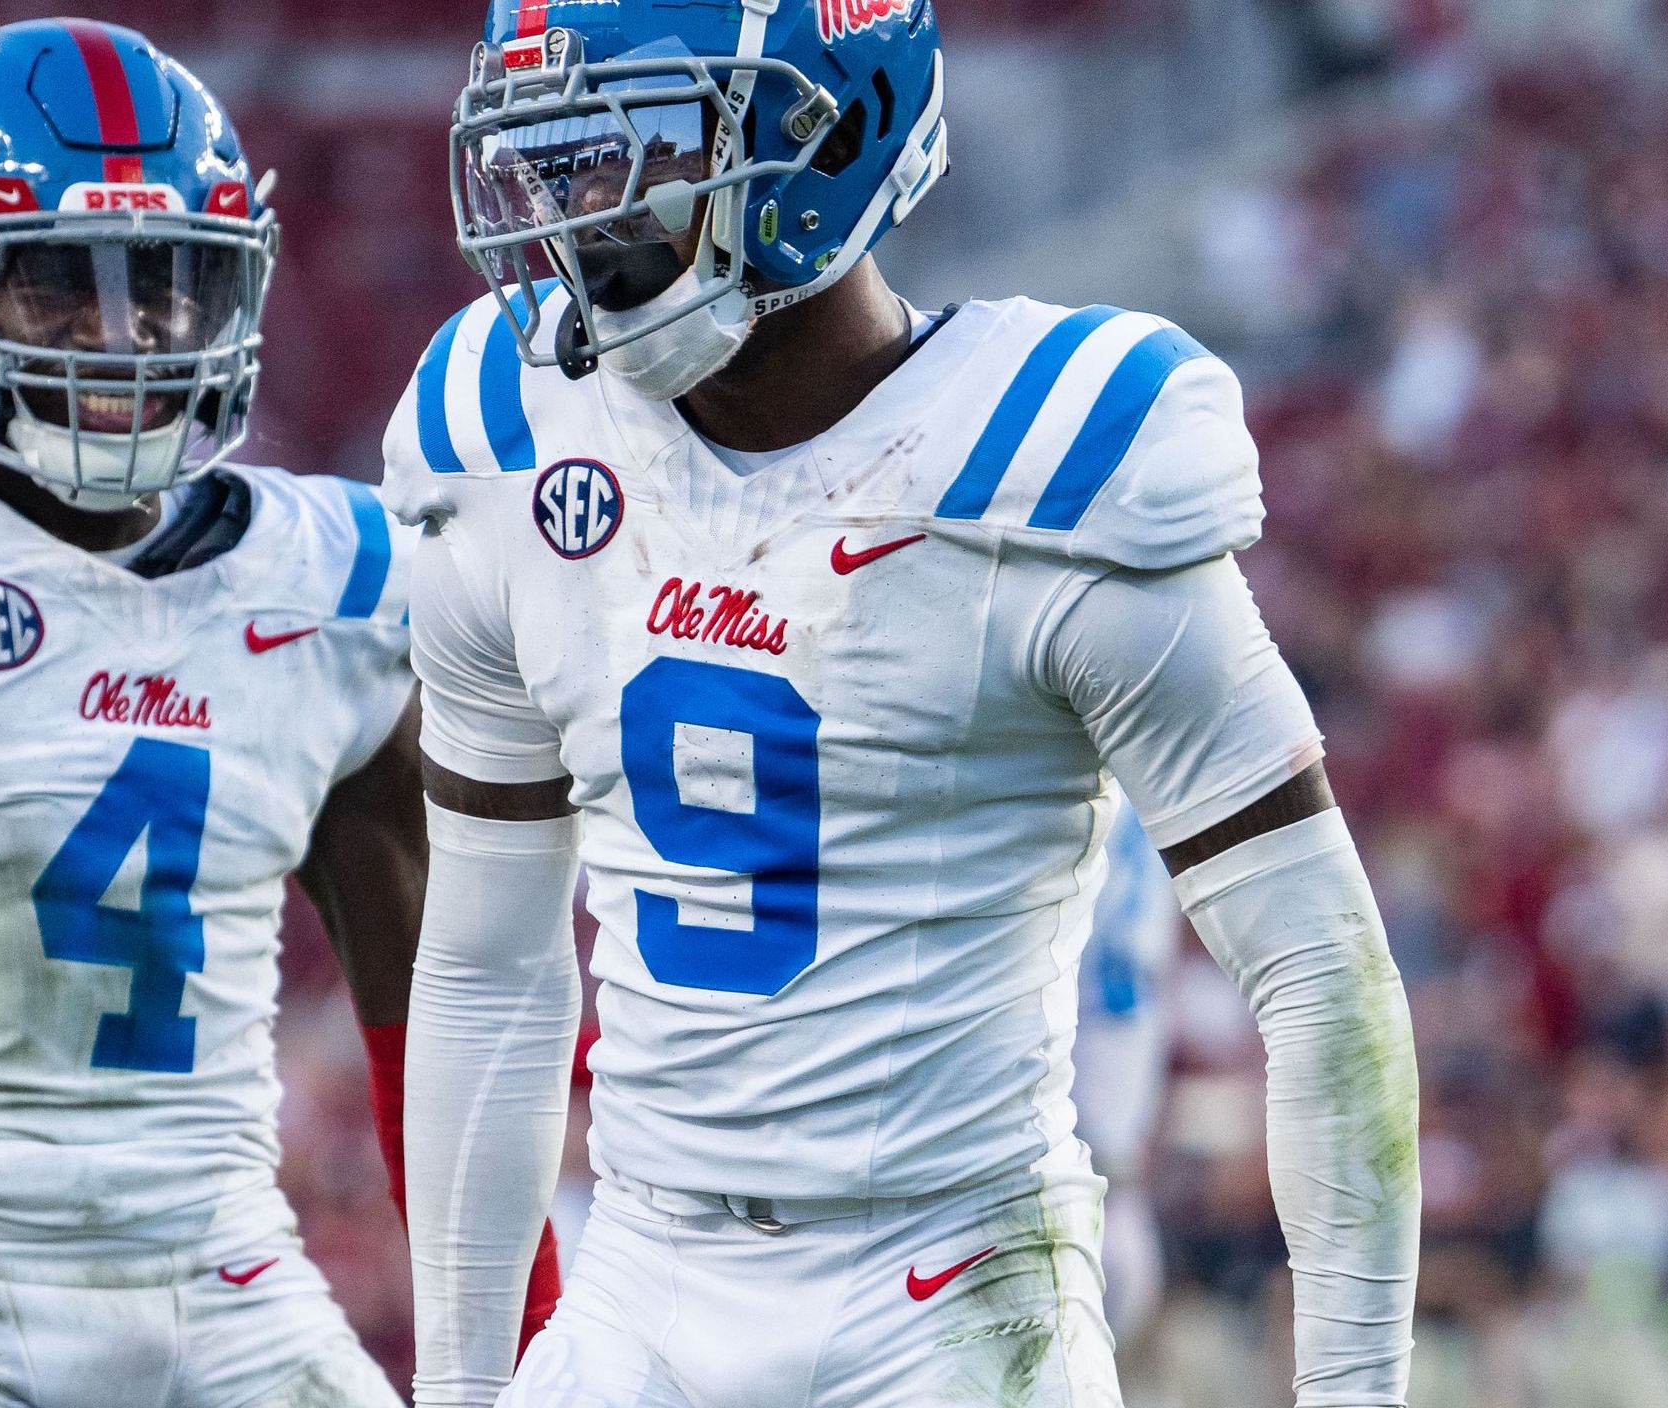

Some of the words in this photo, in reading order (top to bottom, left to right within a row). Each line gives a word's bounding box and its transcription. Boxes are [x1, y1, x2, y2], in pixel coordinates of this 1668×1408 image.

[540, 465, 616, 552] SEC
[647, 577, 706, 641] Ole
[705, 585, 788, 655] Miss
[80, 670, 129, 723] Ole
[131, 672, 211, 729] Miss
[620, 655, 822, 997] 9
[32, 736, 212, 1074] 4
